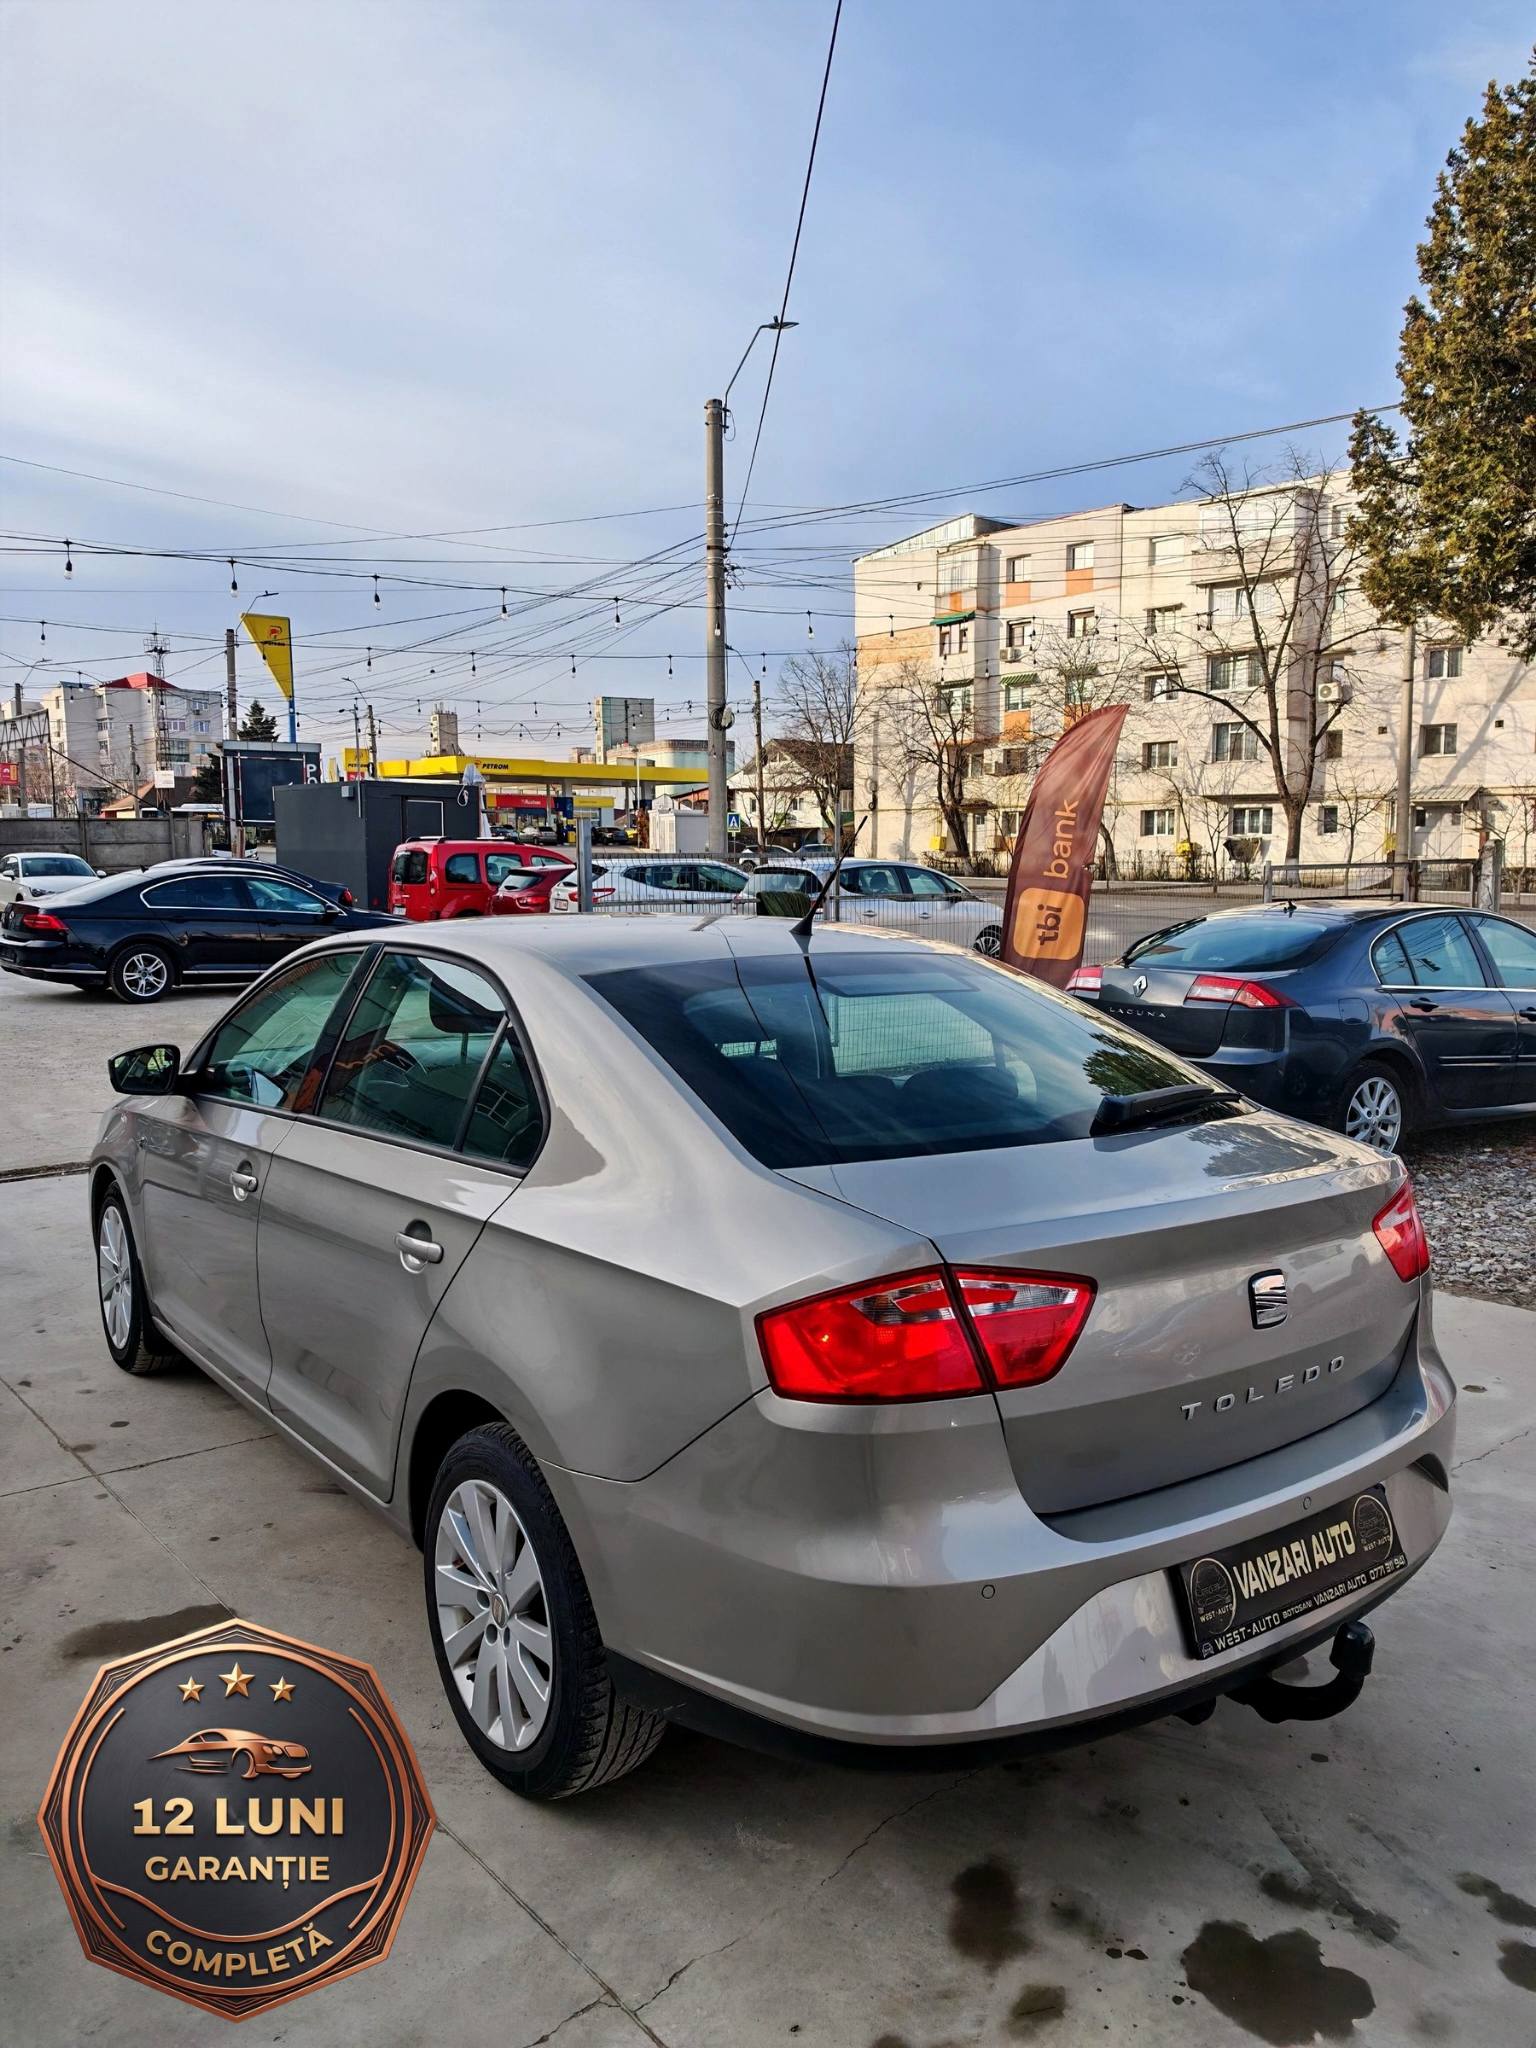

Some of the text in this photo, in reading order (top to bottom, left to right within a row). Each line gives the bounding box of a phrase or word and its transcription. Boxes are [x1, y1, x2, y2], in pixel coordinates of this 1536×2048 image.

[1036, 799, 1080, 946] tbi bank
[1180, 1355, 1345, 1421] TOLEDO
[1233, 1520, 1356, 1599] VANZARI AUTO
[1214, 1612, 1281, 1651] WEST-AUTO
[1313, 1583, 1347, 1606] VANZARI
[1347, 1574, 1367, 1591] AUTO
